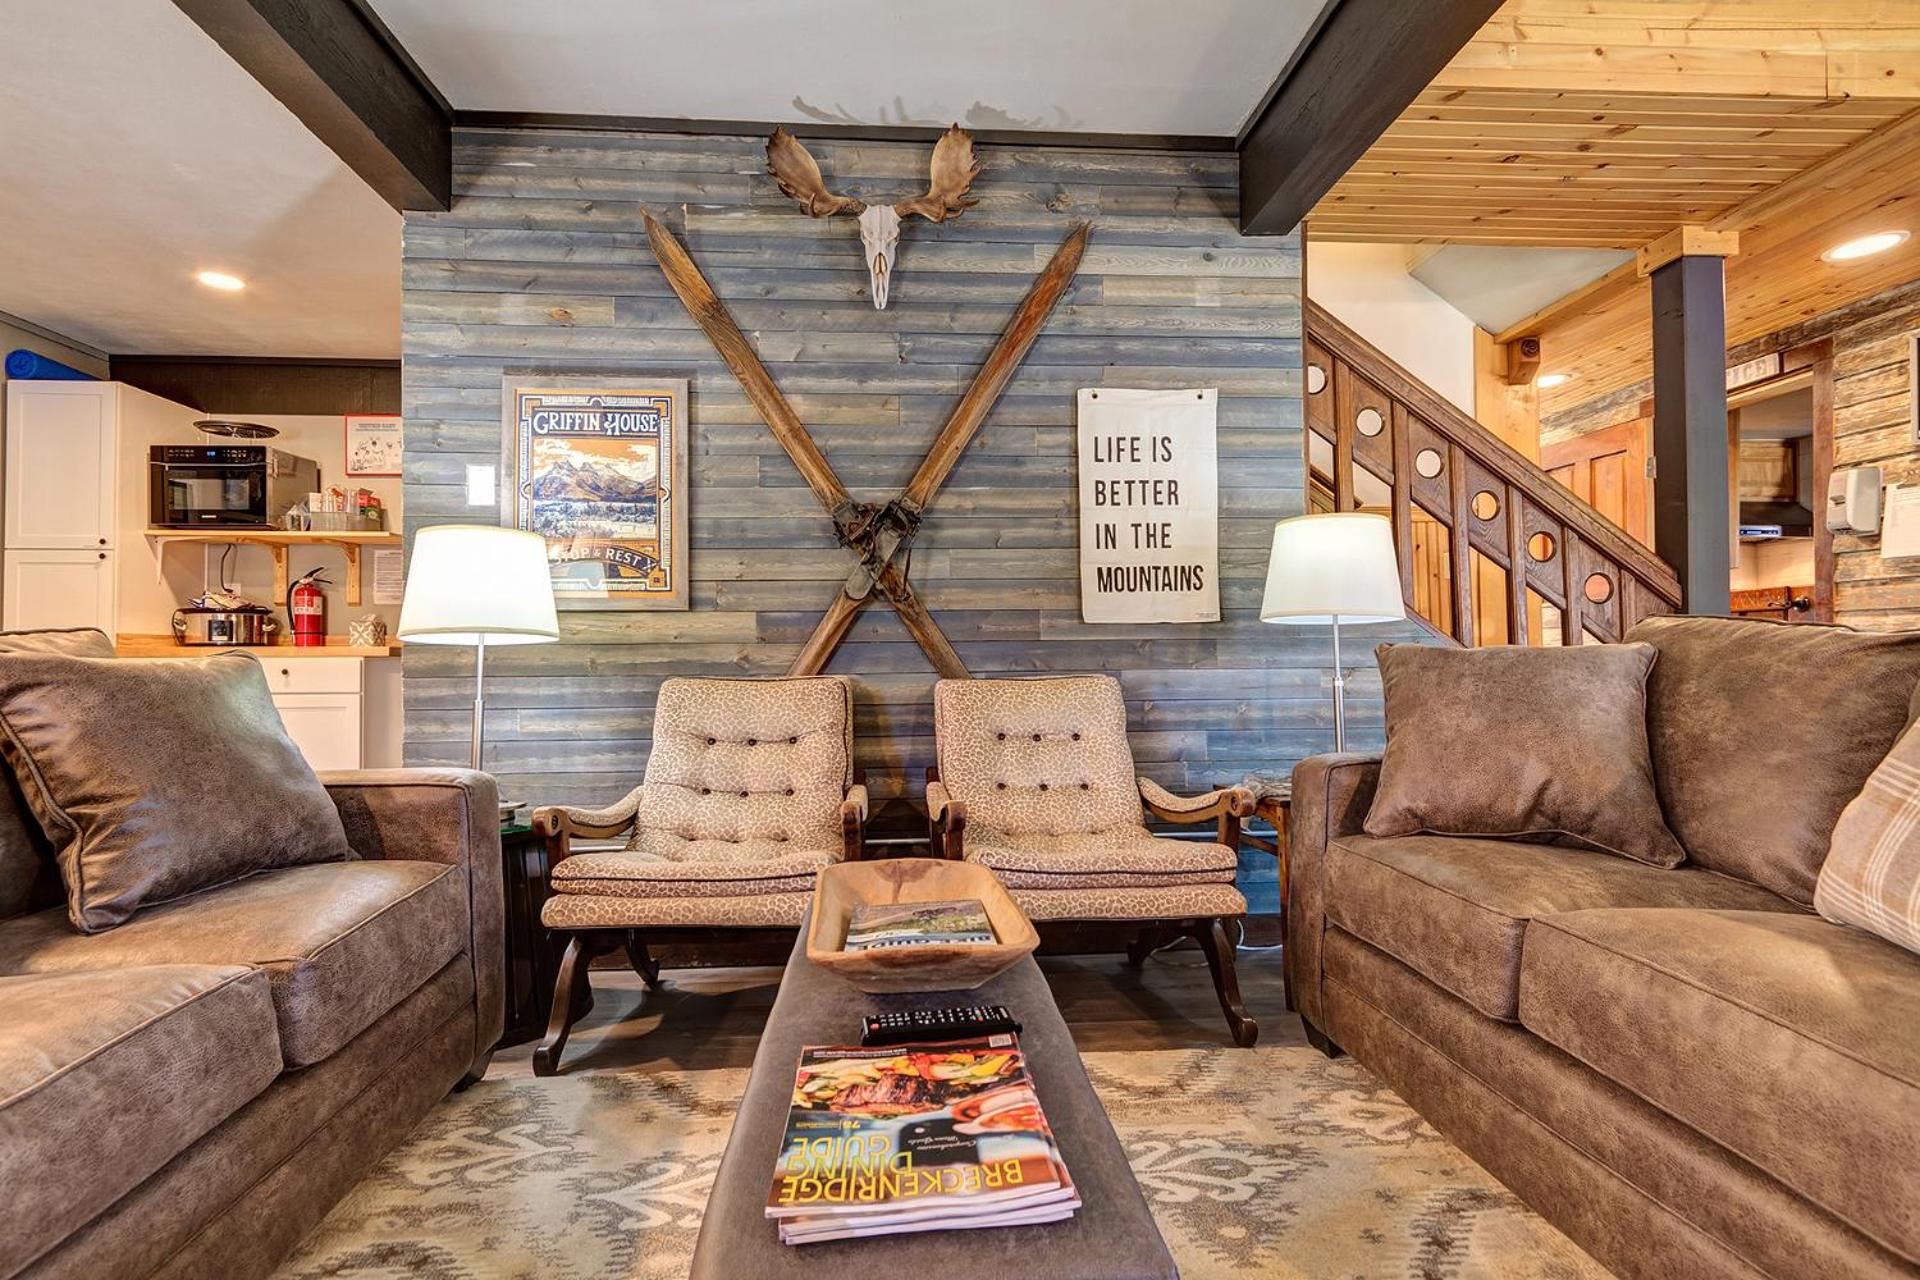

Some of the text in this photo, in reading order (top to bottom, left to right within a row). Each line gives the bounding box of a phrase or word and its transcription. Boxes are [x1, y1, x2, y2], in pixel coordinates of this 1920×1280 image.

[533, 411, 658, 435] GRIFFIN HOUSE
[1094, 436, 1172, 463] LIFE IS
[1095, 480, 1179, 506] BETTER
[1096, 523, 1172, 549] IN THE
[606, 548, 641, 567] REST
[1097, 565, 1204, 593] MOUNTAINS
[793, 1135, 892, 1158] GUIDE
[785, 1151, 912, 1180] DINING
[778, 1158, 1024, 1203] BRECKENRIDGE
